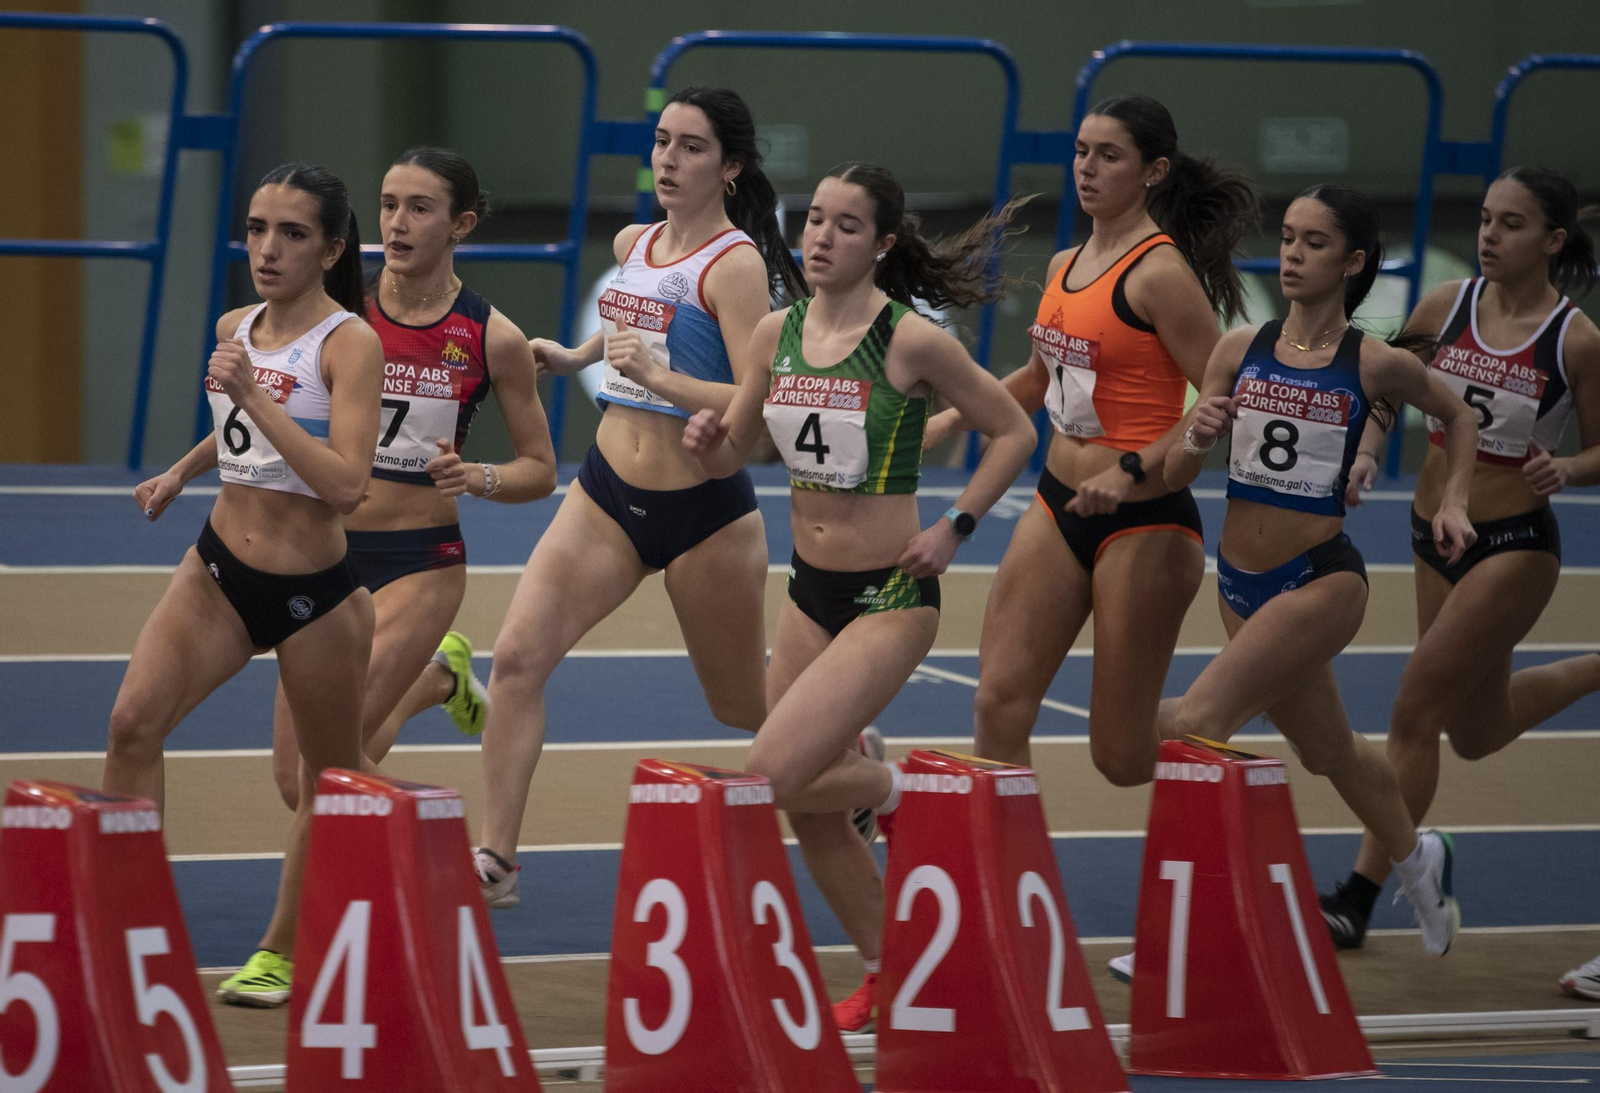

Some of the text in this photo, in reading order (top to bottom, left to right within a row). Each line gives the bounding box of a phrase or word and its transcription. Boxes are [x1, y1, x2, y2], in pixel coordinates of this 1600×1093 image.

[600, 303, 664, 331] OURENSE 2026
[617, 293, 639, 311] COPA
[640, 299, 665, 316] ABS
[1032, 324, 1089, 353] XXI COPA ABS
[384, 363, 450, 382] OPA ABS
[1065, 353, 1091, 367] 2026
[1447, 346, 1538, 381] XXI COPA ABS
[259, 370, 285, 386] ABS
[416, 381, 453, 397] 2026
[778, 375, 860, 394] XXI COPA ABS
[1440, 358, 1538, 396] OURENSE 2026
[773, 391, 862, 410] OURENSE 2026
[1241, 393, 1342, 424] OURENSE 2026
[1246, 380, 1340, 408] XXI COPA ABS
[1463, 384, 1495, 431] 5
[223, 404, 251, 457] 6
[379, 398, 410, 448] 7
[795, 413, 830, 465] 4
[1259, 419, 1299, 472] 8
[1244, 471, 1303, 491] atletismo.gal
[890, 865, 1092, 1032] 2 2
[1159, 860, 1332, 1018] 1 1
[623, 878, 822, 1055] 3 3
[0, 913, 208, 1093] 5 5
[301, 900, 517, 1079] 4 4
